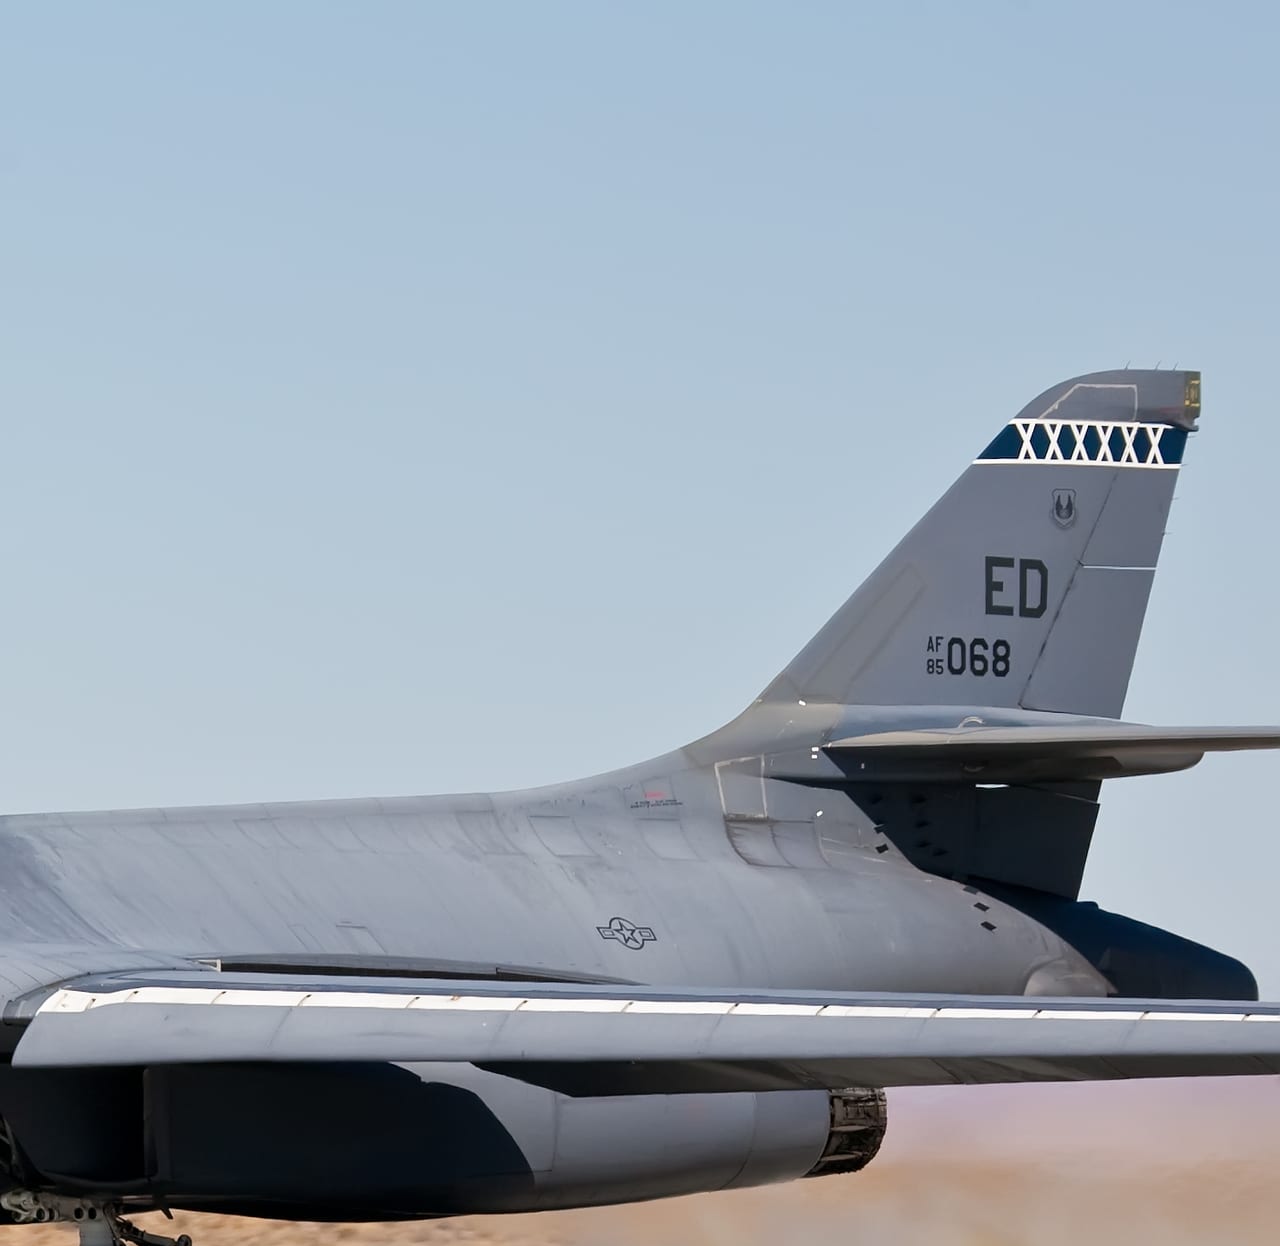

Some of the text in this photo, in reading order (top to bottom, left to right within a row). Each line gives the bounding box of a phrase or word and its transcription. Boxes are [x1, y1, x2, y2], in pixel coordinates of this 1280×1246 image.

[985, 556, 1048, 619] ED
[927, 636, 944, 653] AF
[947, 637, 1011, 677] 068
[926, 658, 945, 675] 85
